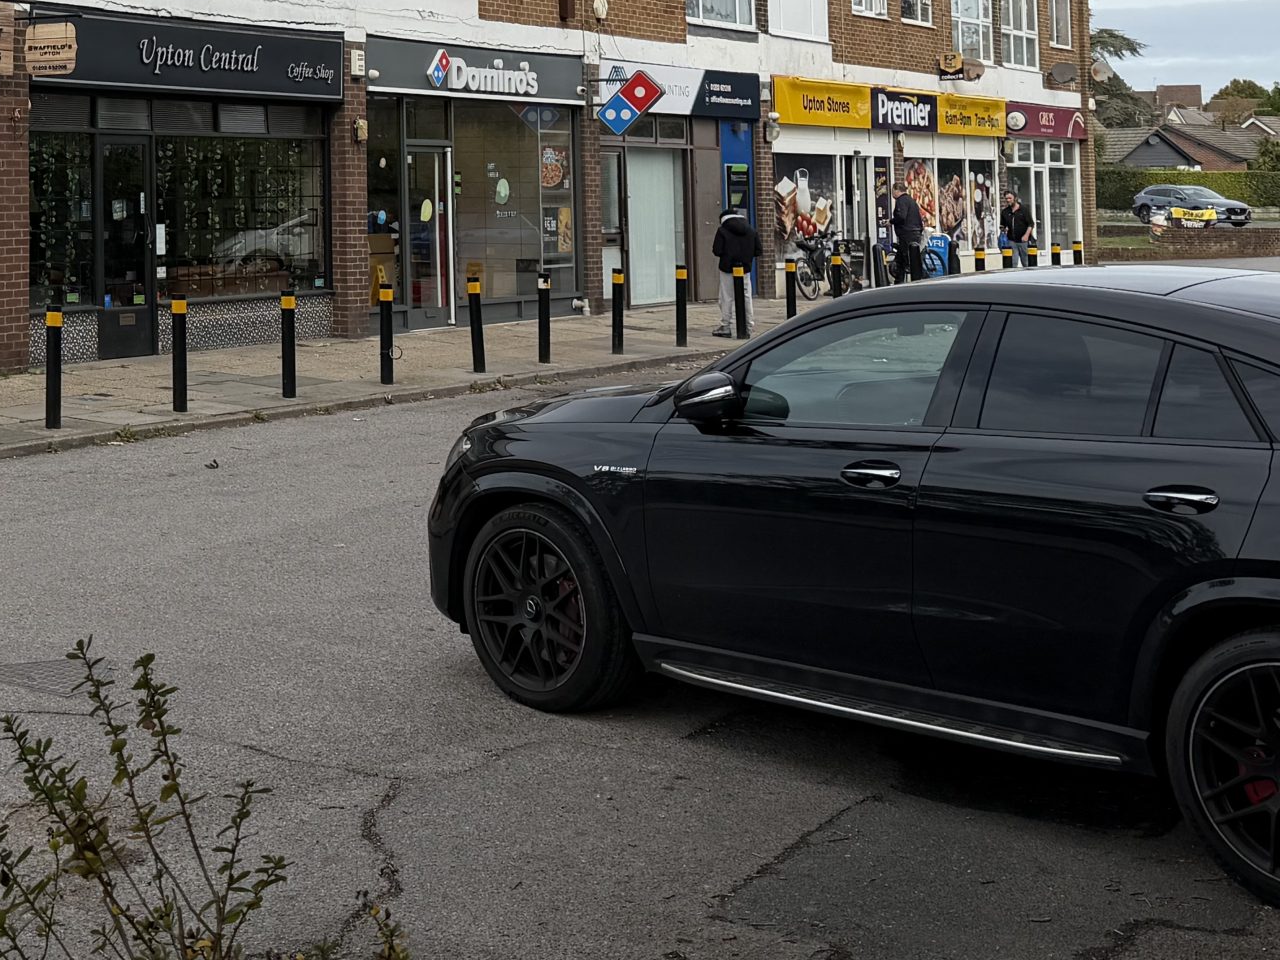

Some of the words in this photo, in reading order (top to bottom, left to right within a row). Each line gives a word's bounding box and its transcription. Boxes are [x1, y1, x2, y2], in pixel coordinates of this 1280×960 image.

[139, 36, 194, 74] Upton
[200, 44, 263, 72] Central
[287, 63, 313, 82] Coffee
[314, 65, 335, 83] Shop
[447, 57, 539, 95] Domino's
[802, 94, 825, 114] Upton
[826, 96, 850, 113] Stores
[877, 93, 931, 127] Premier
